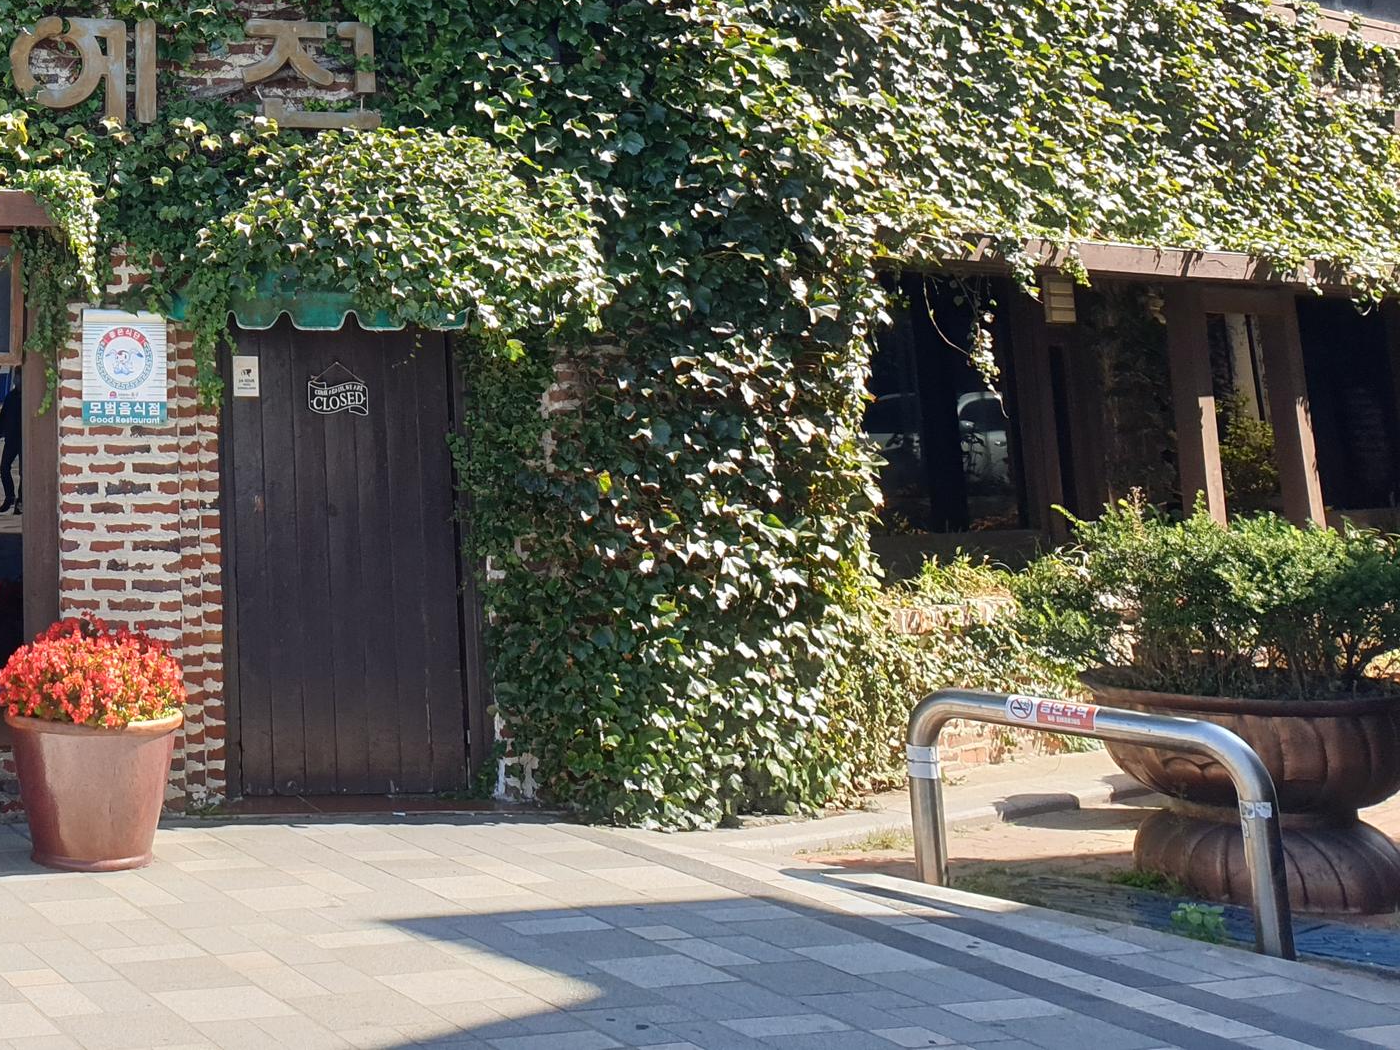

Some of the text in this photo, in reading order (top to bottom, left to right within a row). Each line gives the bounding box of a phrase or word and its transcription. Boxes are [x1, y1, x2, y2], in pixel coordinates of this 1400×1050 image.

[89, 402, 160, 416] 모범음식점
[312, 392, 365, 411] CLOSED
[89, 416, 160, 424] Good Restaurant
[1040, 701, 1090, 719] 금연구역
